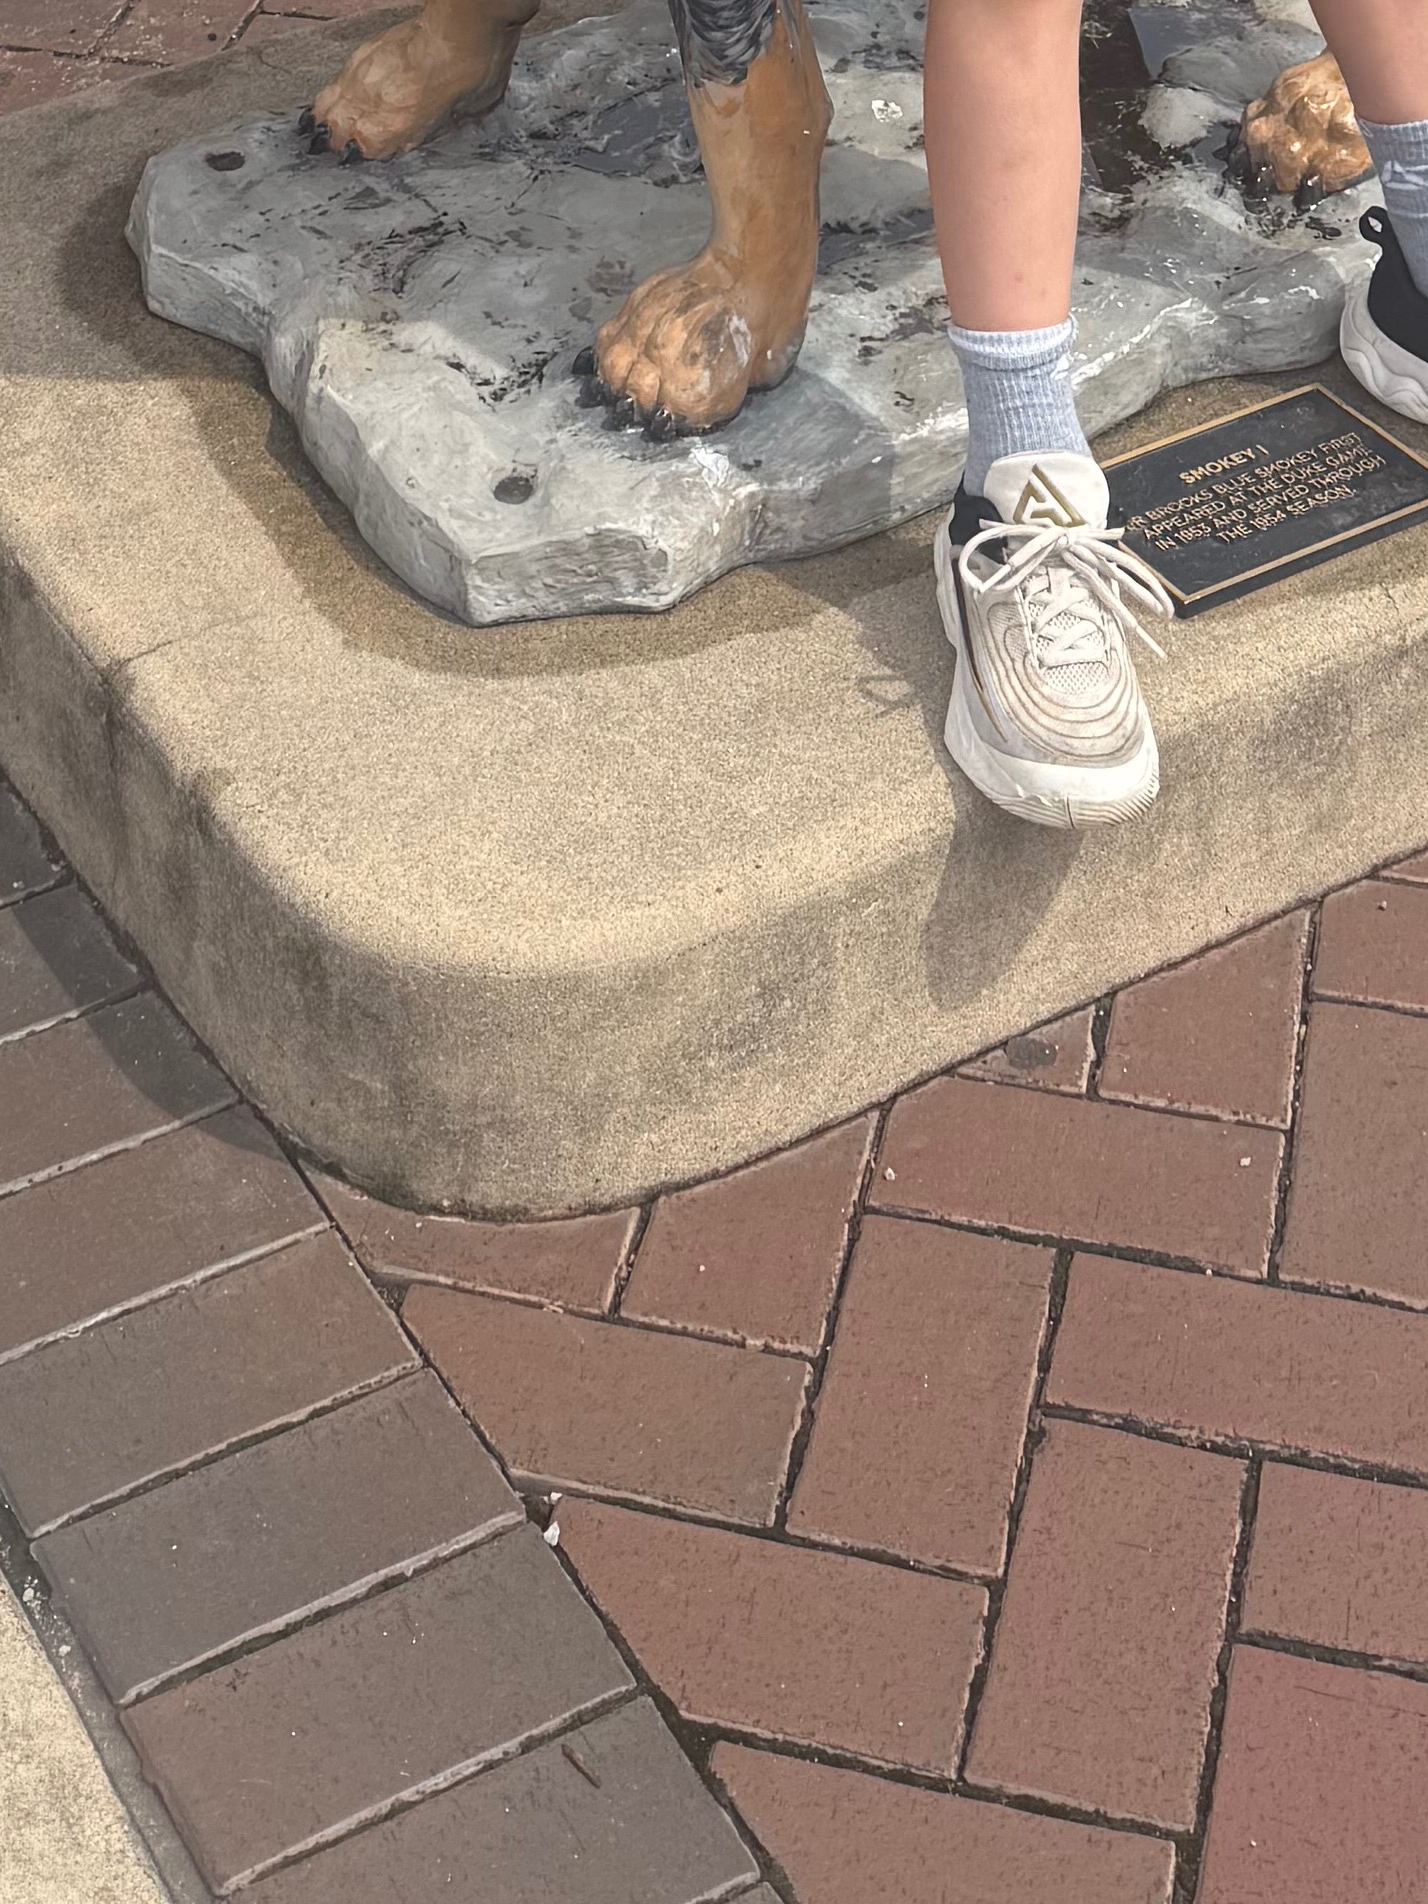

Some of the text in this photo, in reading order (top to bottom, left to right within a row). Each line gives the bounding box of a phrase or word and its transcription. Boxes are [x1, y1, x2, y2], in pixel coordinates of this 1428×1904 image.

[1143, 444, 1373, 540] APPEARED AT THE DUKE GAME
[1144, 488, 1214, 521] BROOKS
[1211, 472, 1257, 494] BLUE
[1254, 447, 1319, 478] SMOKEY
[1317, 432, 1364, 454] FIRST
[1154, 535, 1177, 551] IN
[1212, 508, 1247, 529] AND
[1247, 484, 1310, 514] SERVED
[1307, 454, 1387, 489] THROUGH
[1178, 447, 1256, 484] SMOKEY
[1215, 523, 1253, 544] THE
